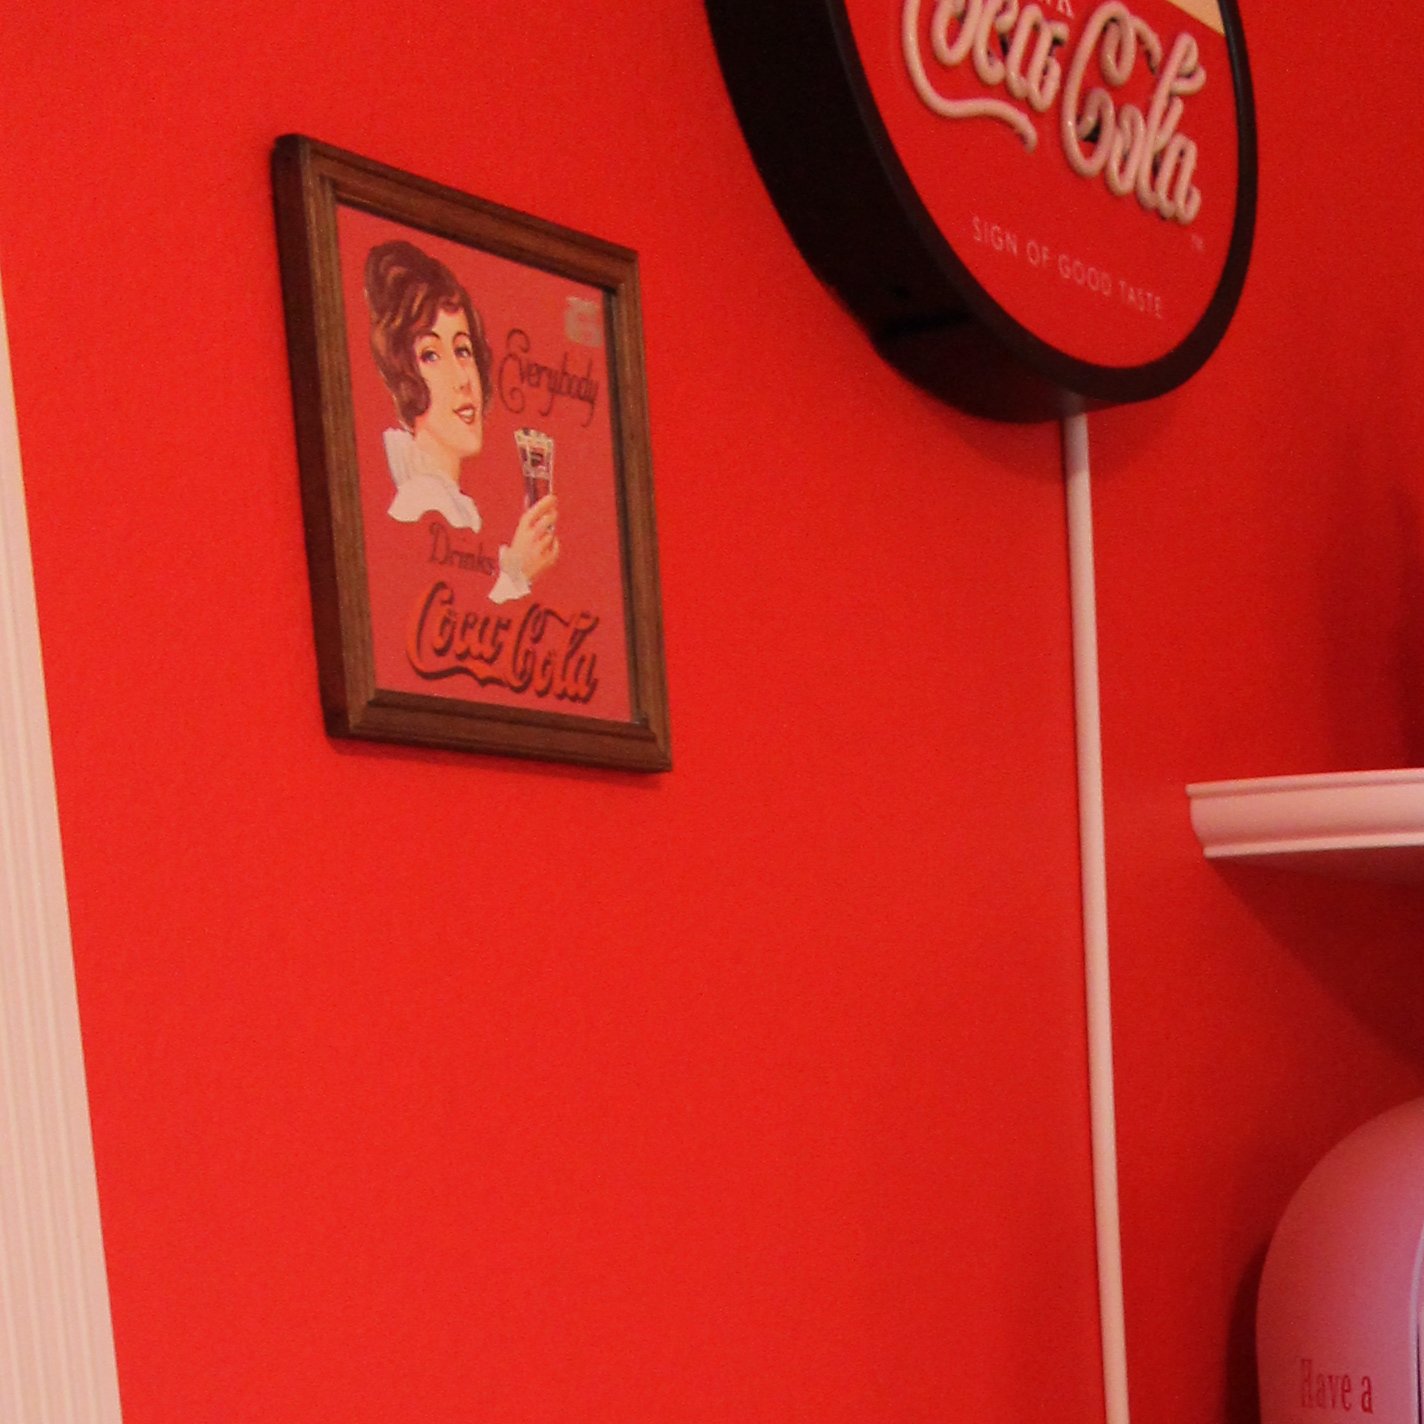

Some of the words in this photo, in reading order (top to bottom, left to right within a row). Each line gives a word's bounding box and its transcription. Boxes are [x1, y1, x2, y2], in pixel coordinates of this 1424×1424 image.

[972, 216, 1018, 256] SIGN
[1026, 240, 1050, 266] OF
[1058, 253, 1112, 296] GOOD
[1119, 280, 1162, 319] TASTE
[498, 328, 599, 428] Everybody
[1301, 1358, 1351, 1412] Have
[1361, 1375, 1373, 1414] a
